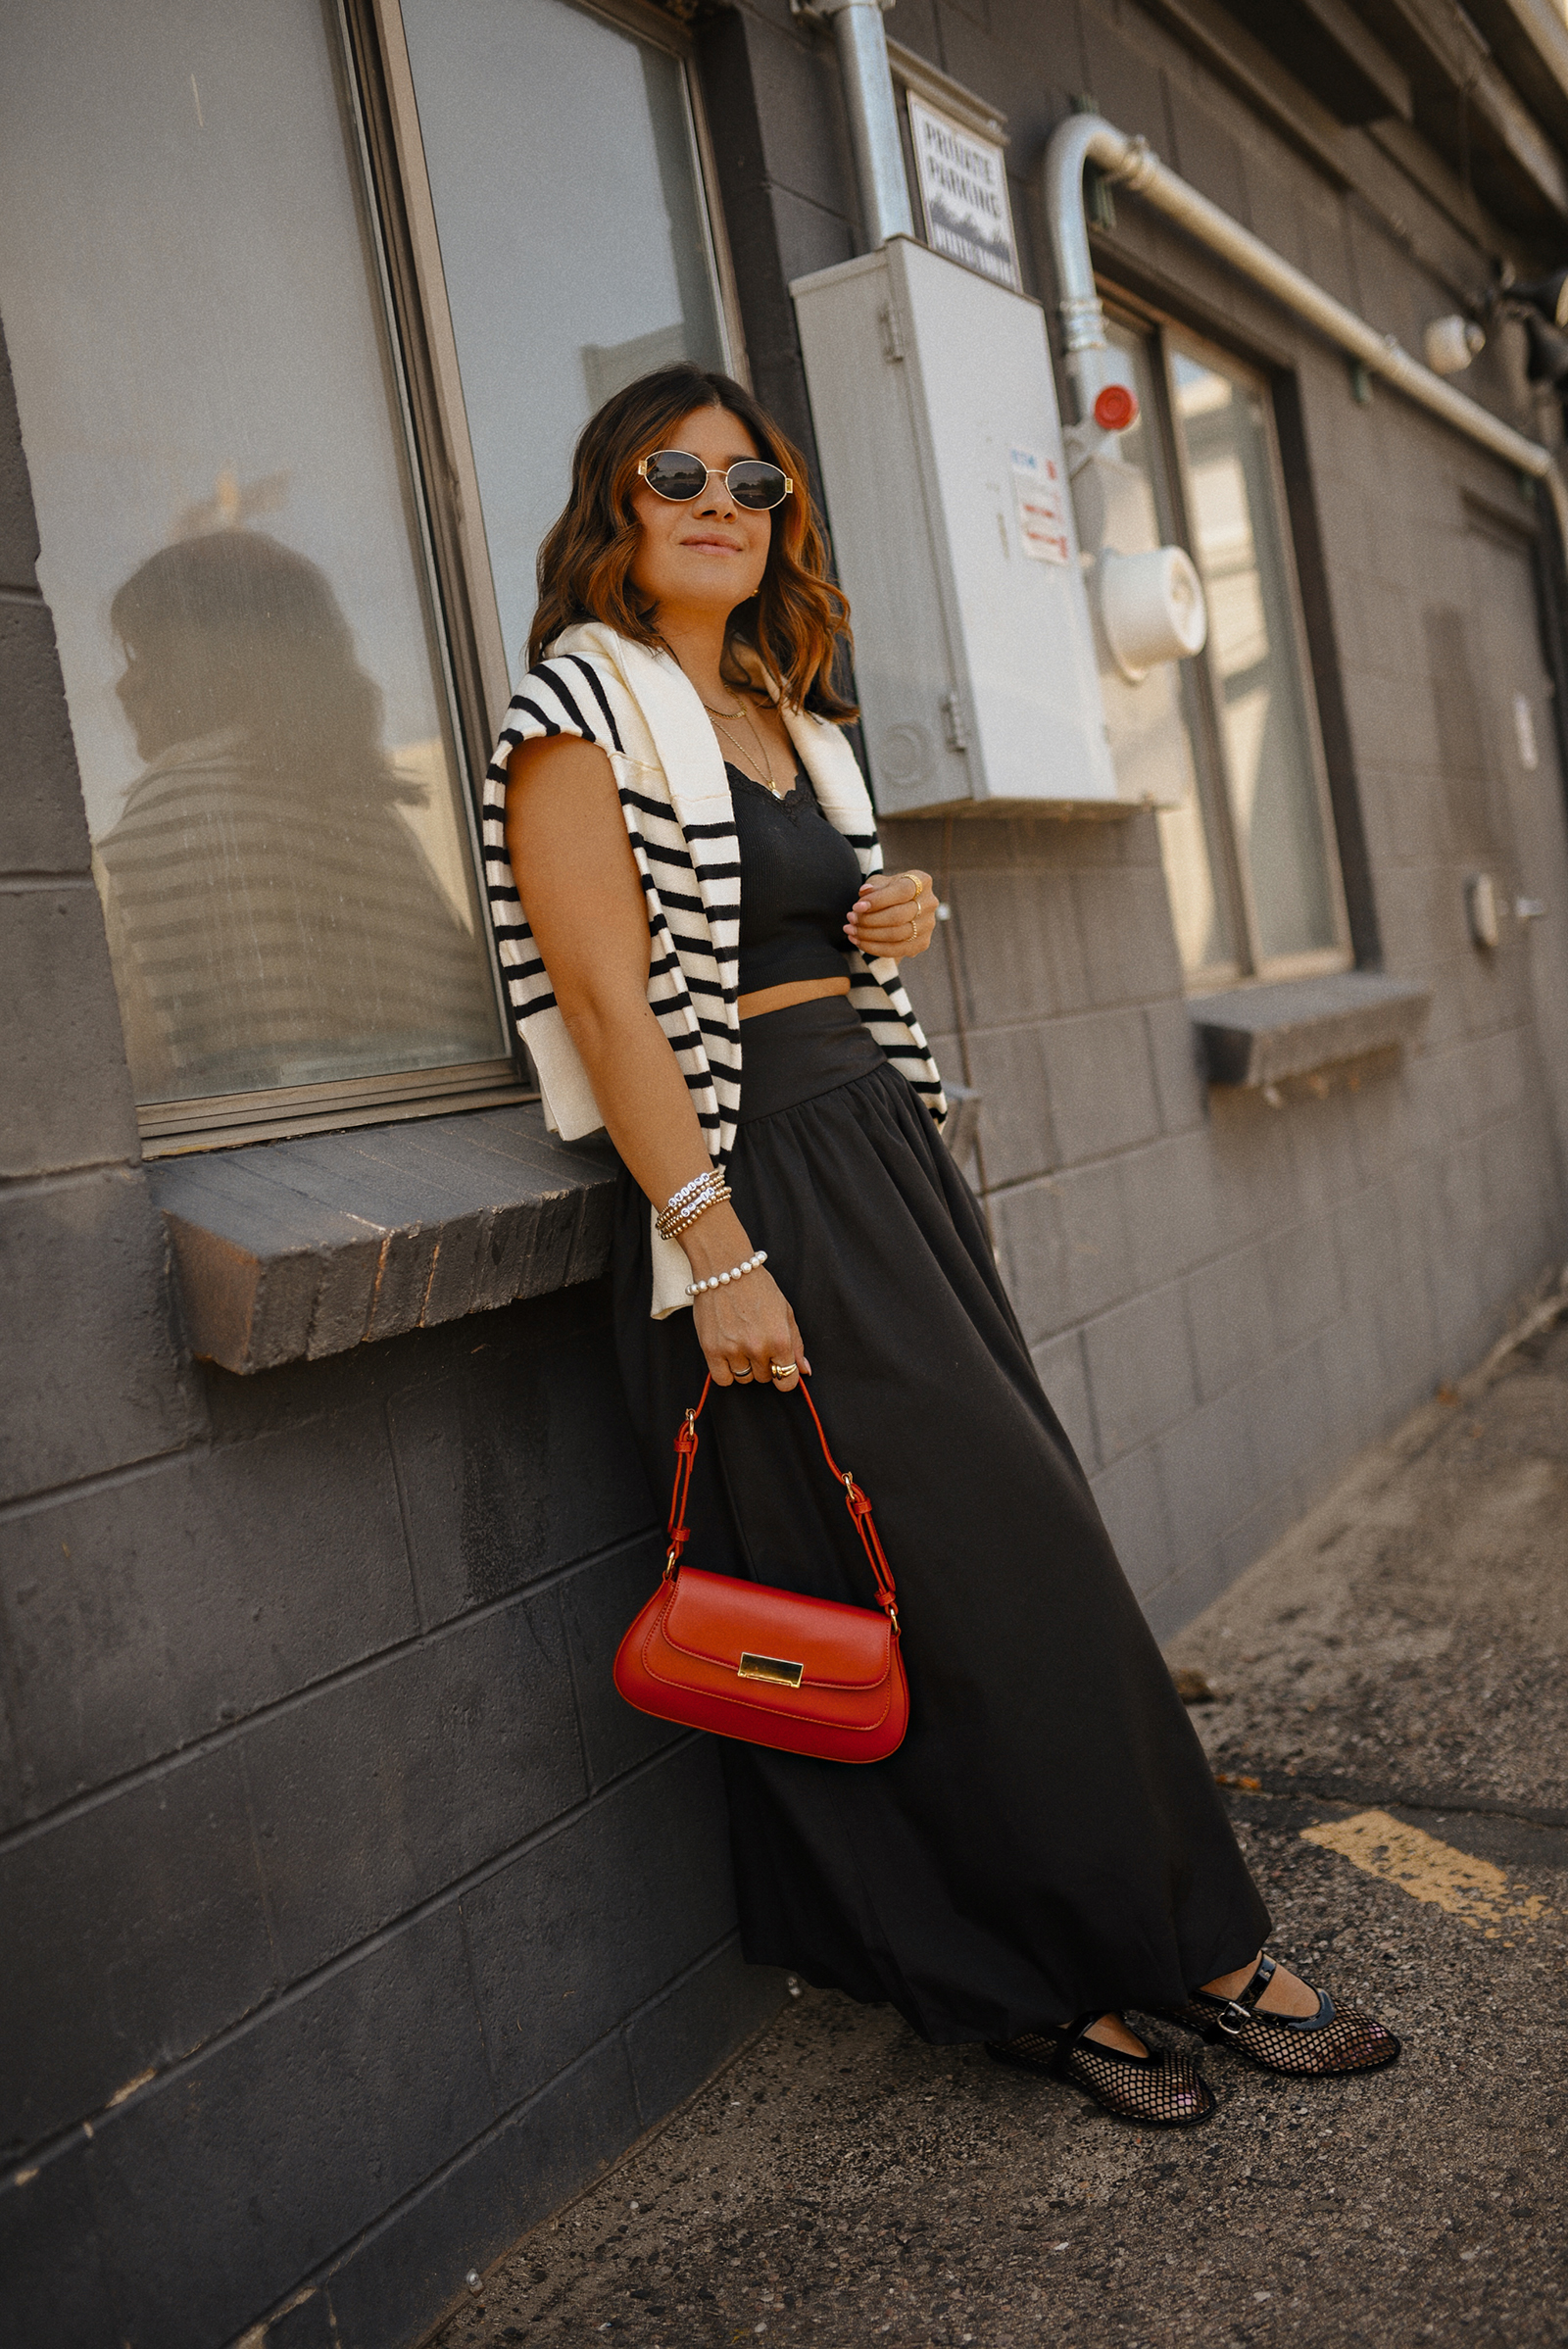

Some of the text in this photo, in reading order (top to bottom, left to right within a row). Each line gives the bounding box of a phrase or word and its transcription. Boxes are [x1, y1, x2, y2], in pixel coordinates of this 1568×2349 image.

[925, 120, 995, 186] PRIVATE
[928, 154, 1002, 220] PARKING
[669, 1173, 710, 1206] MATIAS
[682, 1188, 714, 1216] SOIA
